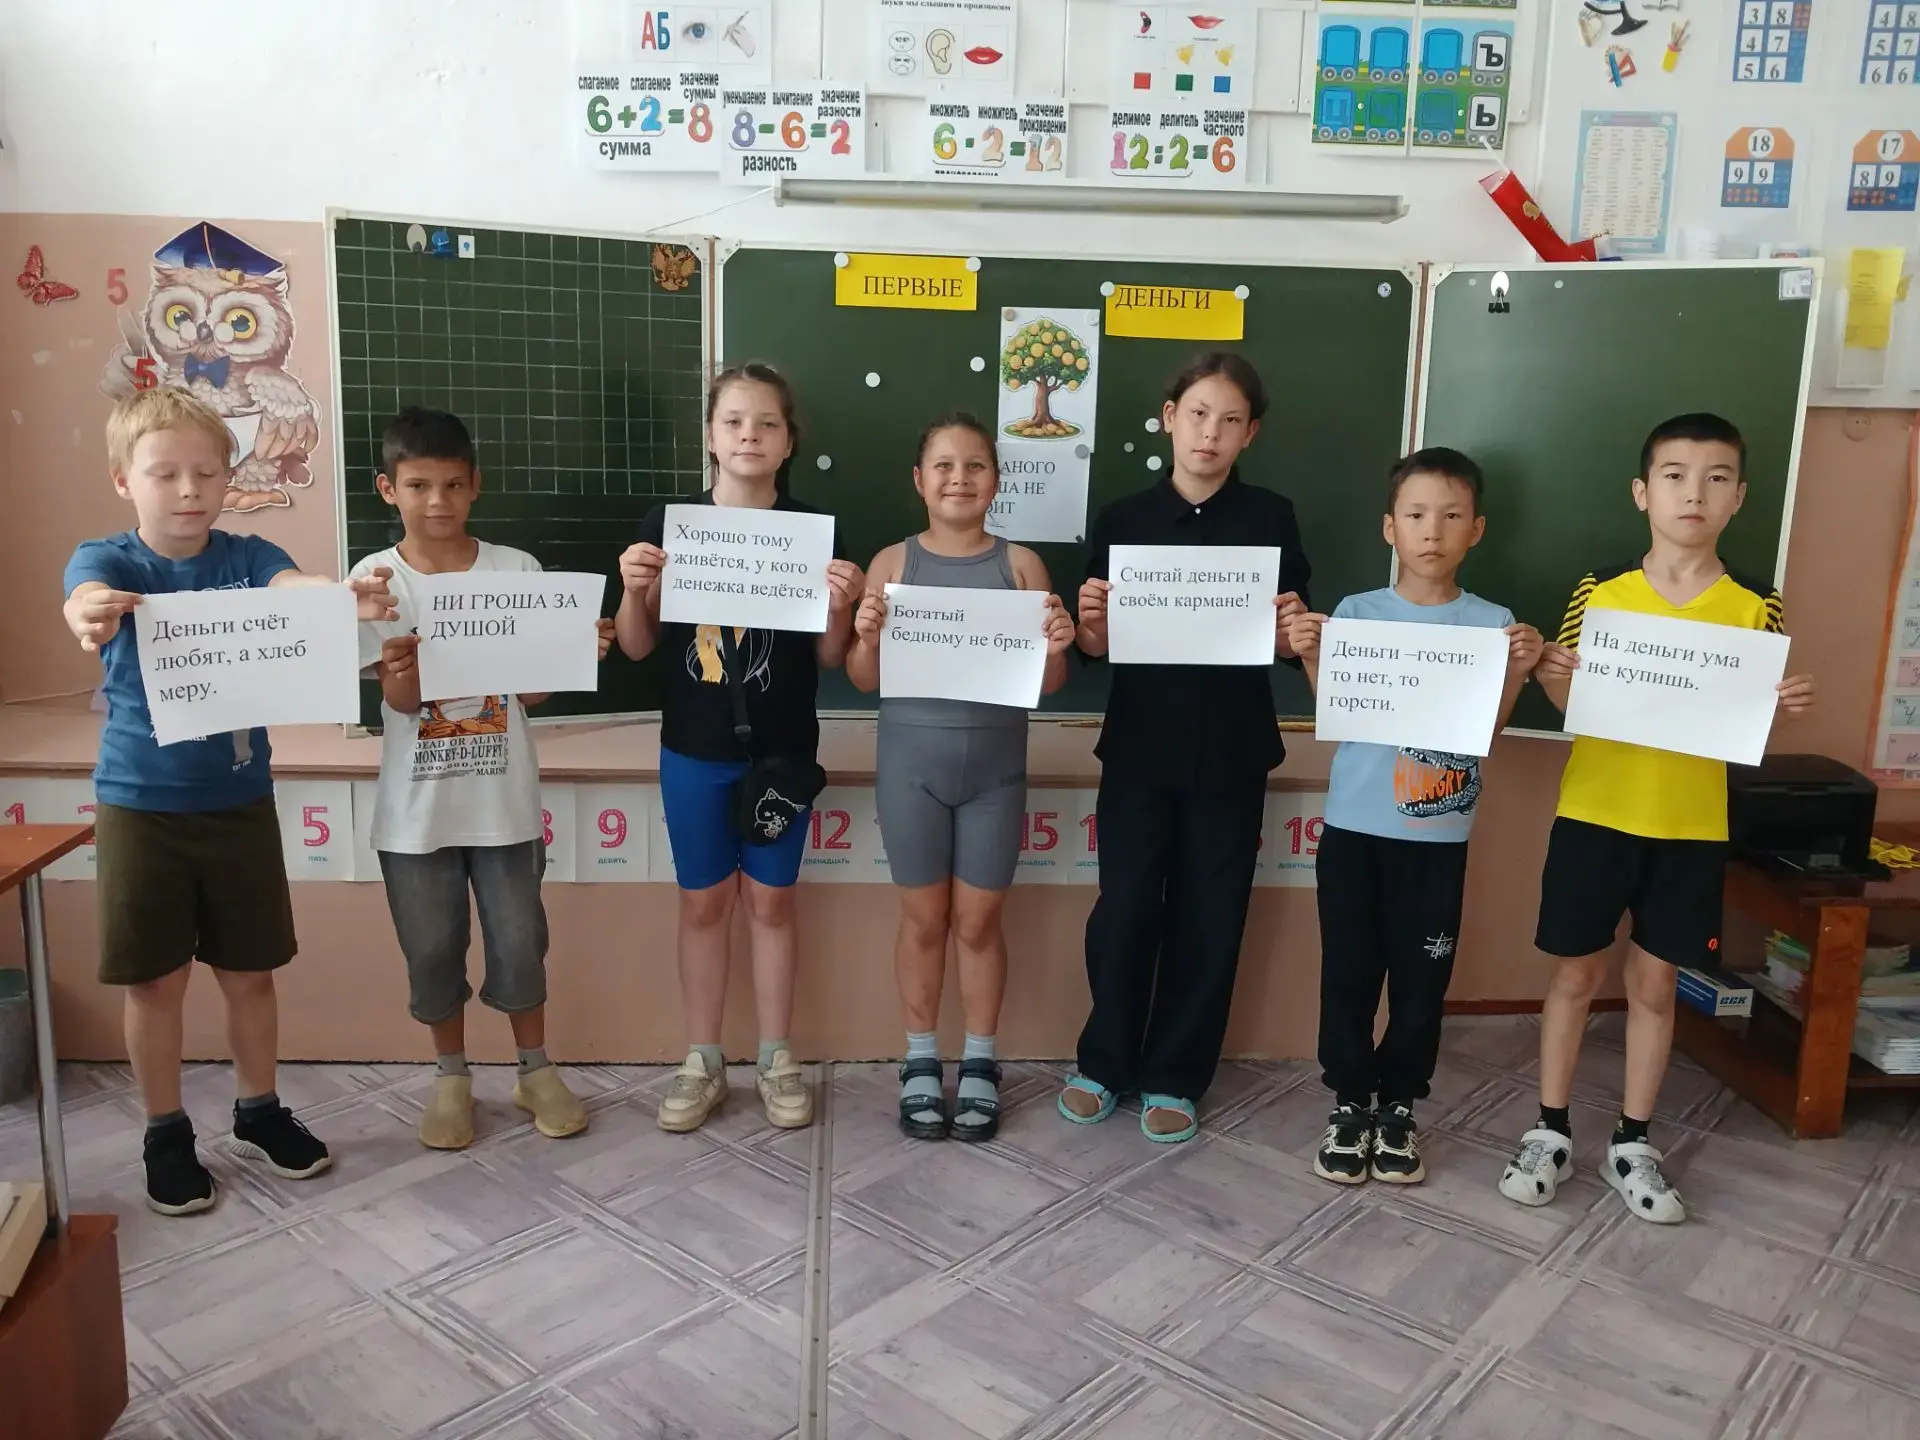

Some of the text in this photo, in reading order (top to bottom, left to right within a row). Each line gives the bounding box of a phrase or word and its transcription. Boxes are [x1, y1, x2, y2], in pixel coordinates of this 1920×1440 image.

[1748, 8, 1787, 25] 3 8
[1879, 11, 1917, 27] 4 8
[641, 10, 670, 50] АБ
[1746, 36, 1784, 51] 4 7
[1875, 39, 1914, 56] 5 7
[1480, 43, 1504, 67] Ъ
[1743, 63, 1780, 79] 5 6
[1871, 67, 1908, 84] 6 6
[578, 72, 719, 91] слагаемое слагаемое значение
[684, 87, 716, 103] суммы
[821, 89, 860, 103] значение
[818, 106, 861, 120] разности
[930, 104, 1064, 120] множитель множитель значение
[1112, 110, 1245, 129] делимое делитель значение
[1475, 103, 1497, 127] Ь
[1203, 123, 1245, 137] частного
[599, 141, 651, 160] сумма
[1751, 135, 1771, 152] 18
[1881, 138, 1901, 154] 17
[743, 156, 797, 176] разность
[1734, 167, 1769, 182] 9 9
[1860, 171, 1895, 187] 8 9
[107, 268, 128, 305] 5
[863, 274, 963, 298] ПЕРВЫЕ
[1115, 286, 1212, 311] ДЕНЬГИ
[134, 358, 158, 391] 5
[1000, 461, 1056, 474] АНОГО
[1024, 482, 1045, 495] НЕ
[675, 524, 794, 552] Хорошо тому
[674, 552, 808, 575] живётся, у кого
[1120, 567, 1260, 584] Считай деньги в
[672, 578, 818, 600] денежка ведётся.
[433, 593, 579, 611] НИ ГРОША ЗА
[1119, 593, 1250, 611] своём кармане!
[893, 605, 965, 622] Богатый
[152, 613, 290, 643] Деньги счёт
[431, 615, 516, 640] ДУШОЙ
[891, 626, 1035, 651] бедному не брат.
[155, 639, 307, 671] любят, а хлеб
[1332, 640, 1399, 660] Деньги
[1592, 631, 1741, 669] На деньги ума
[1330, 669, 1420, 688] то нет, то
[1587, 661, 1699, 691] не купишь.
[159, 681, 217, 703] меру.
[1329, 695, 1396, 712] горсти.
[449, 738, 466, 747] OR
[470, 735, 504, 746] ALIVE
[303, 806, 330, 847] 5
[598, 808, 627, 848] 9
[809, 810, 851, 849] 12
